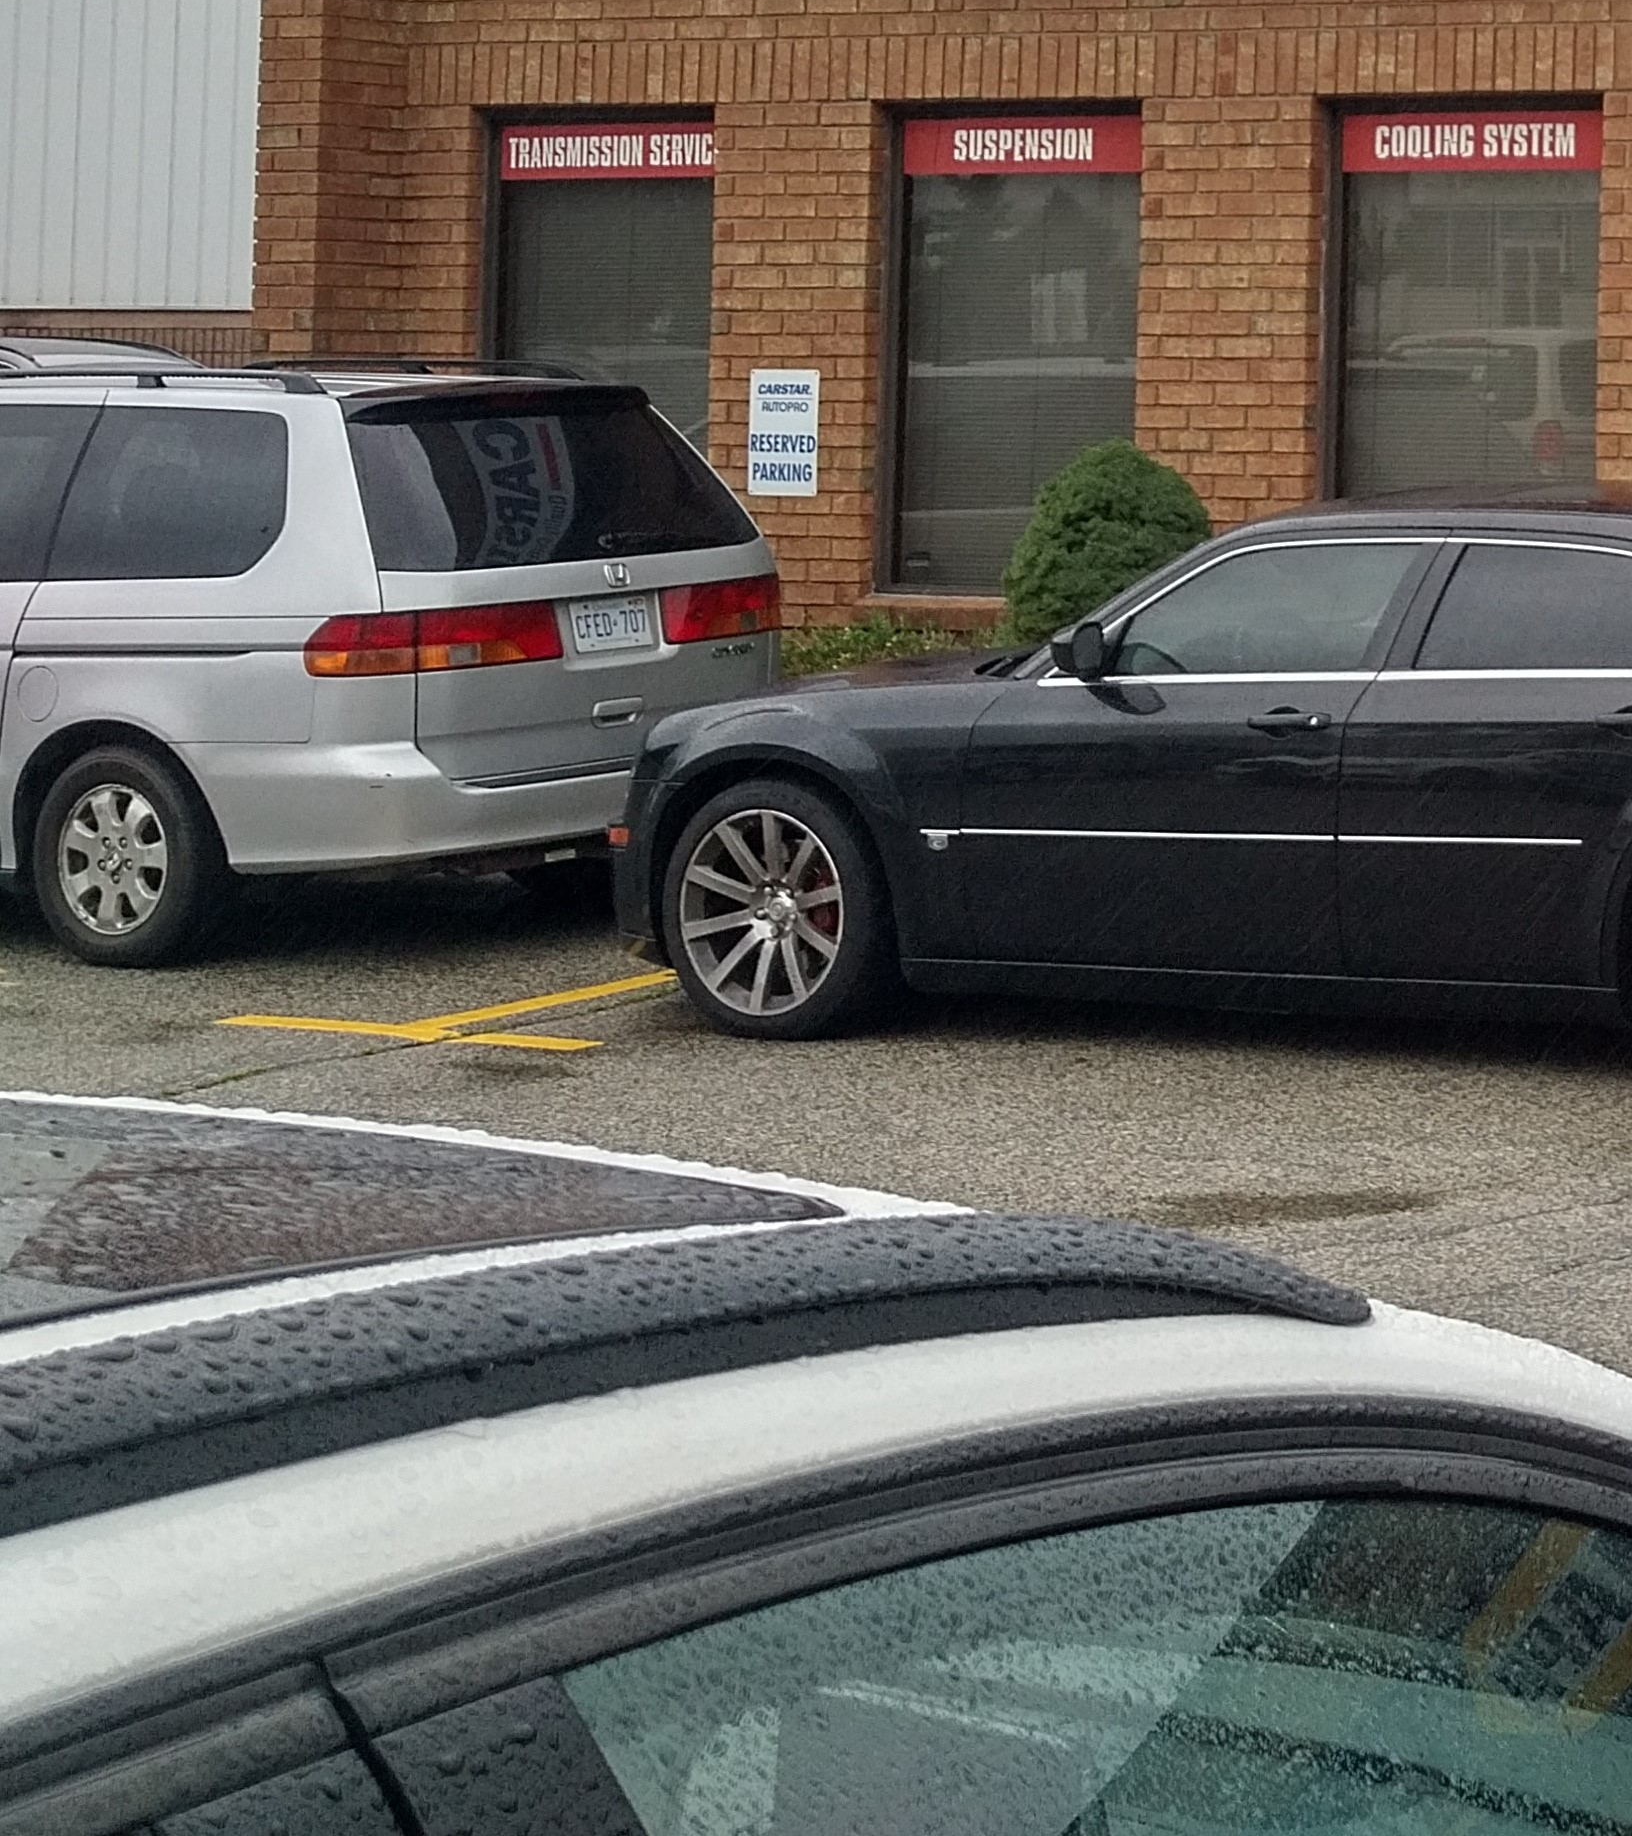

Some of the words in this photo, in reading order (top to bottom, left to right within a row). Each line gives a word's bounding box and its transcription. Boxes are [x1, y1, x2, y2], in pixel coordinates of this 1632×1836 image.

[509, 135, 643, 169] TRANSMISSION
[649, 133, 719, 166] SERVIC
[953, 126, 1094, 163] SUSPENSION
[1374, 122, 1474, 161] COOLING
[1483, 121, 1577, 159] SYSTEM
[757, 383, 811, 395] CARSTAR
[761, 401, 809, 413] AUTOPRO
[750, 433, 816, 454] RESERVED
[752, 462, 813, 482] PARKING
[576, 612, 613, 639] CFED
[619, 609, 646, 635] 707
